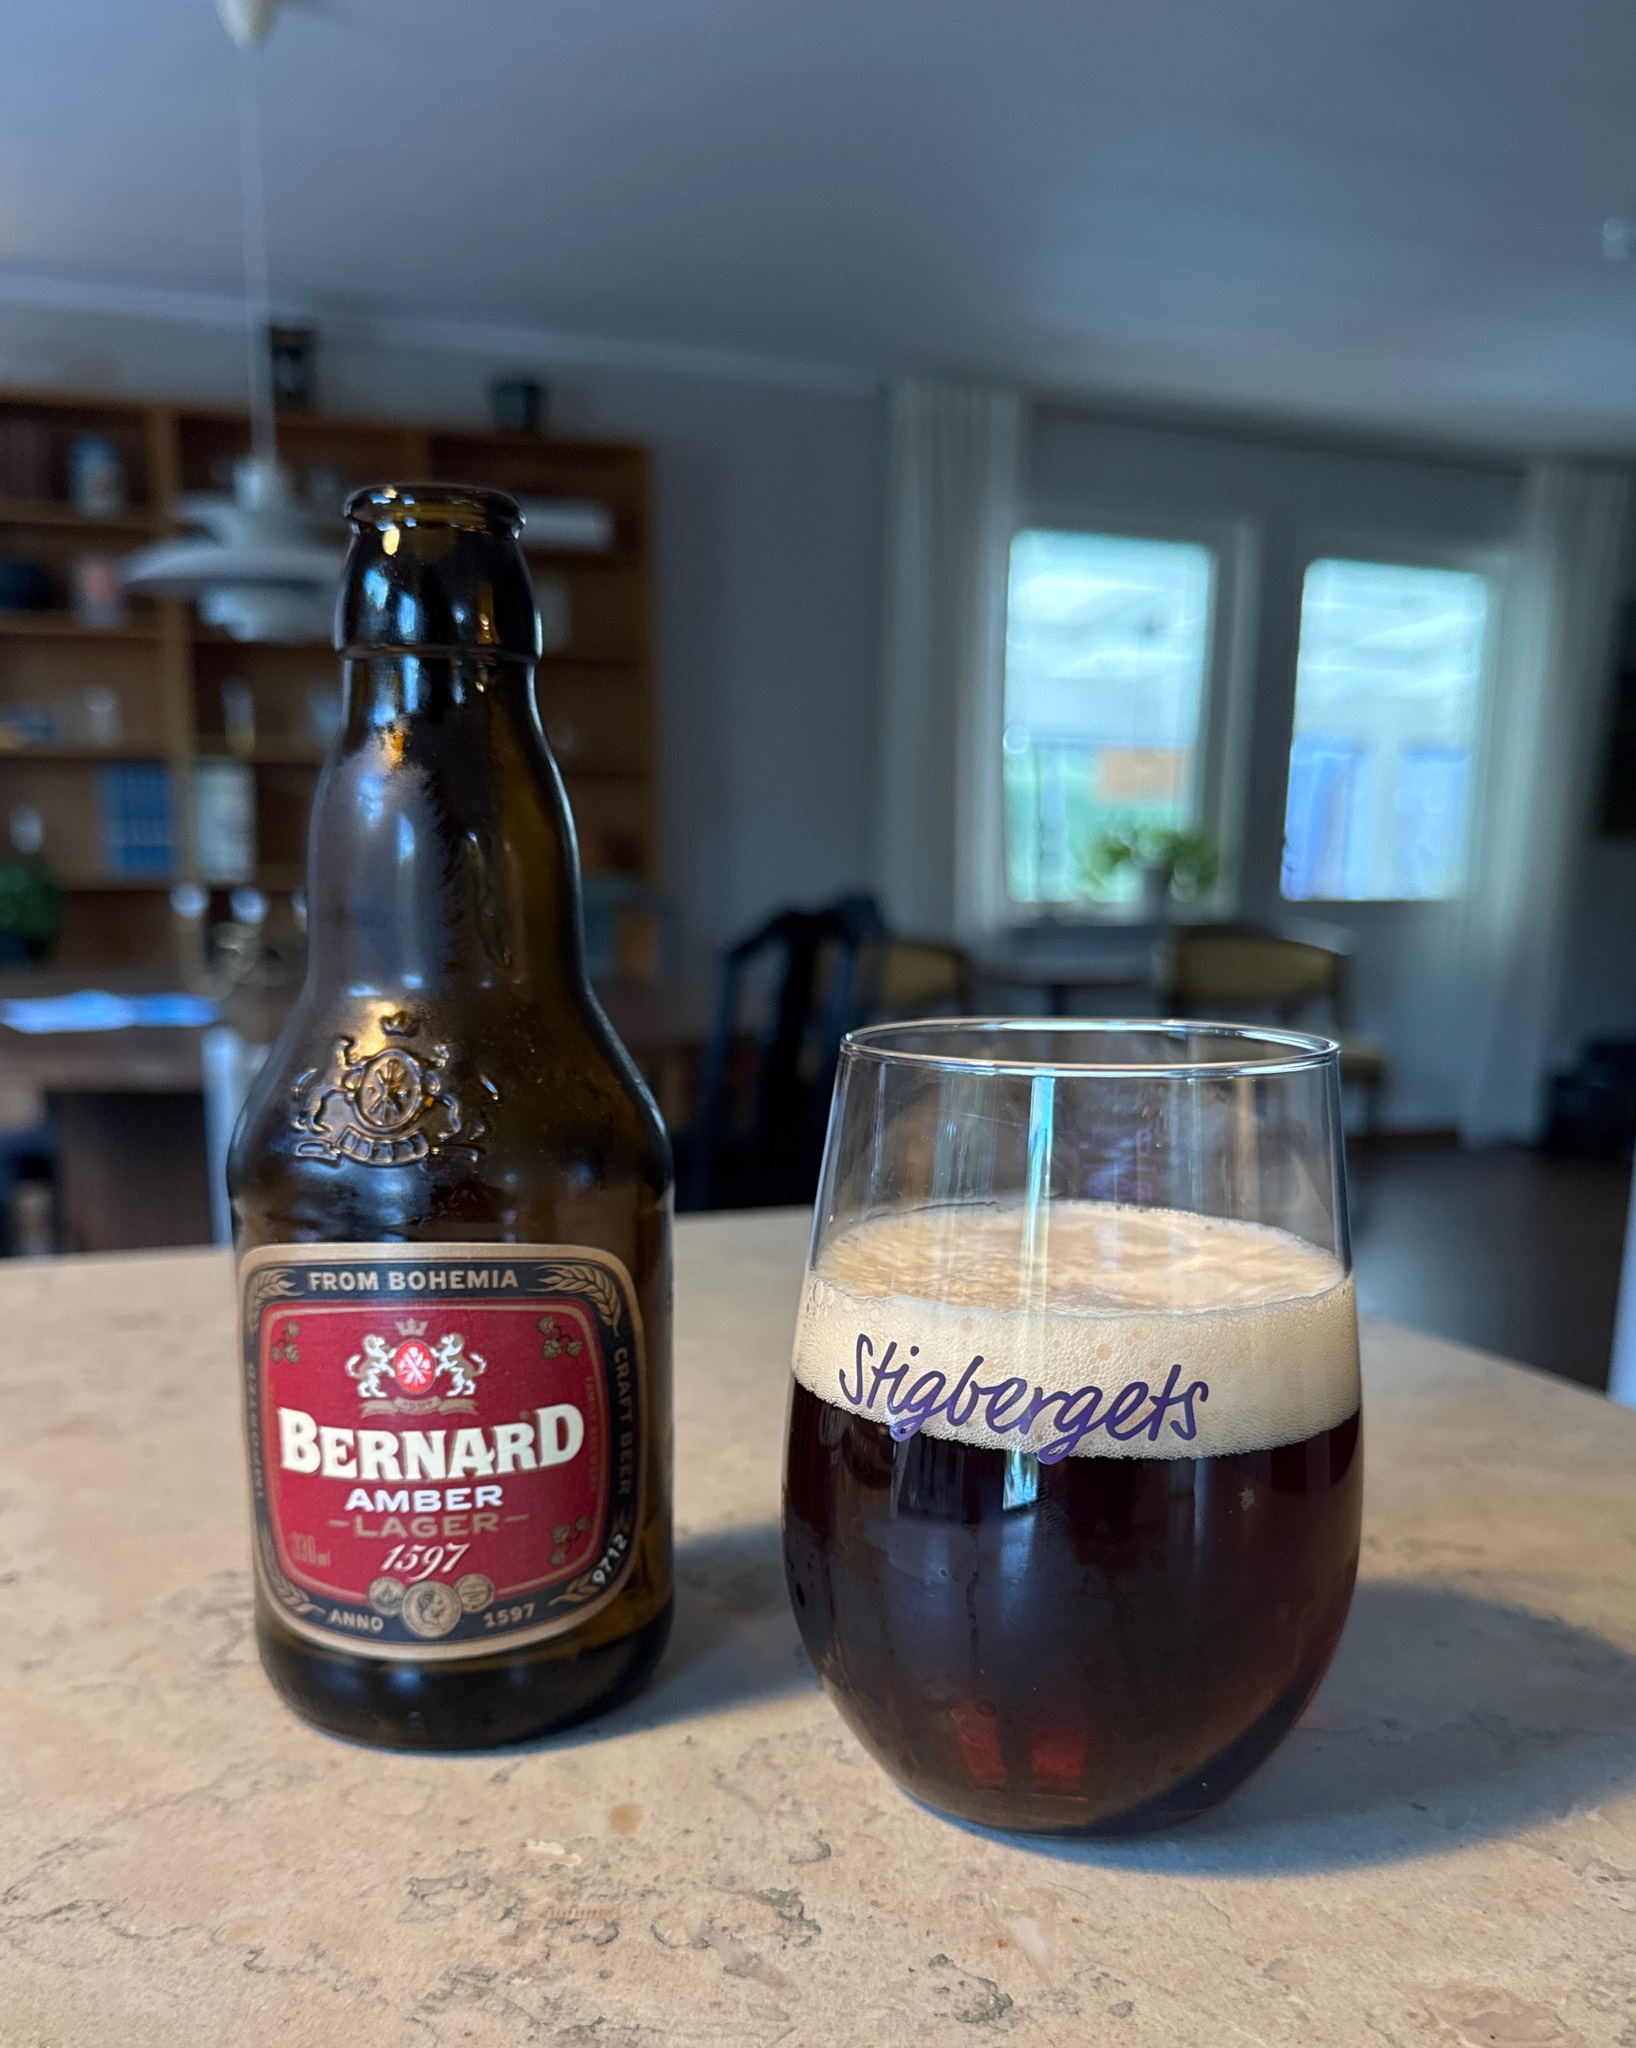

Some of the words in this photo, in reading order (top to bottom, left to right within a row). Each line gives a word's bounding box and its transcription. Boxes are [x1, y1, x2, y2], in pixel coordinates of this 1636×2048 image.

[308, 1271, 379, 1291] FROM
[388, 1269, 519, 1290] BOHEMIA
[613, 1347, 633, 1421] CRAFT
[838, 1333, 1209, 1465] Stigbergets
[277, 1403, 584, 1481] BERNARD
[618, 1431, 634, 1494] BEER
[344, 1484, 503, 1513] AMBER
[380, 1542, 471, 1582] 1597
[592, 1533, 628, 1584] 9712
[328, 1608, 384, 1633] ANNO
[482, 1602, 536, 1628] 1597
